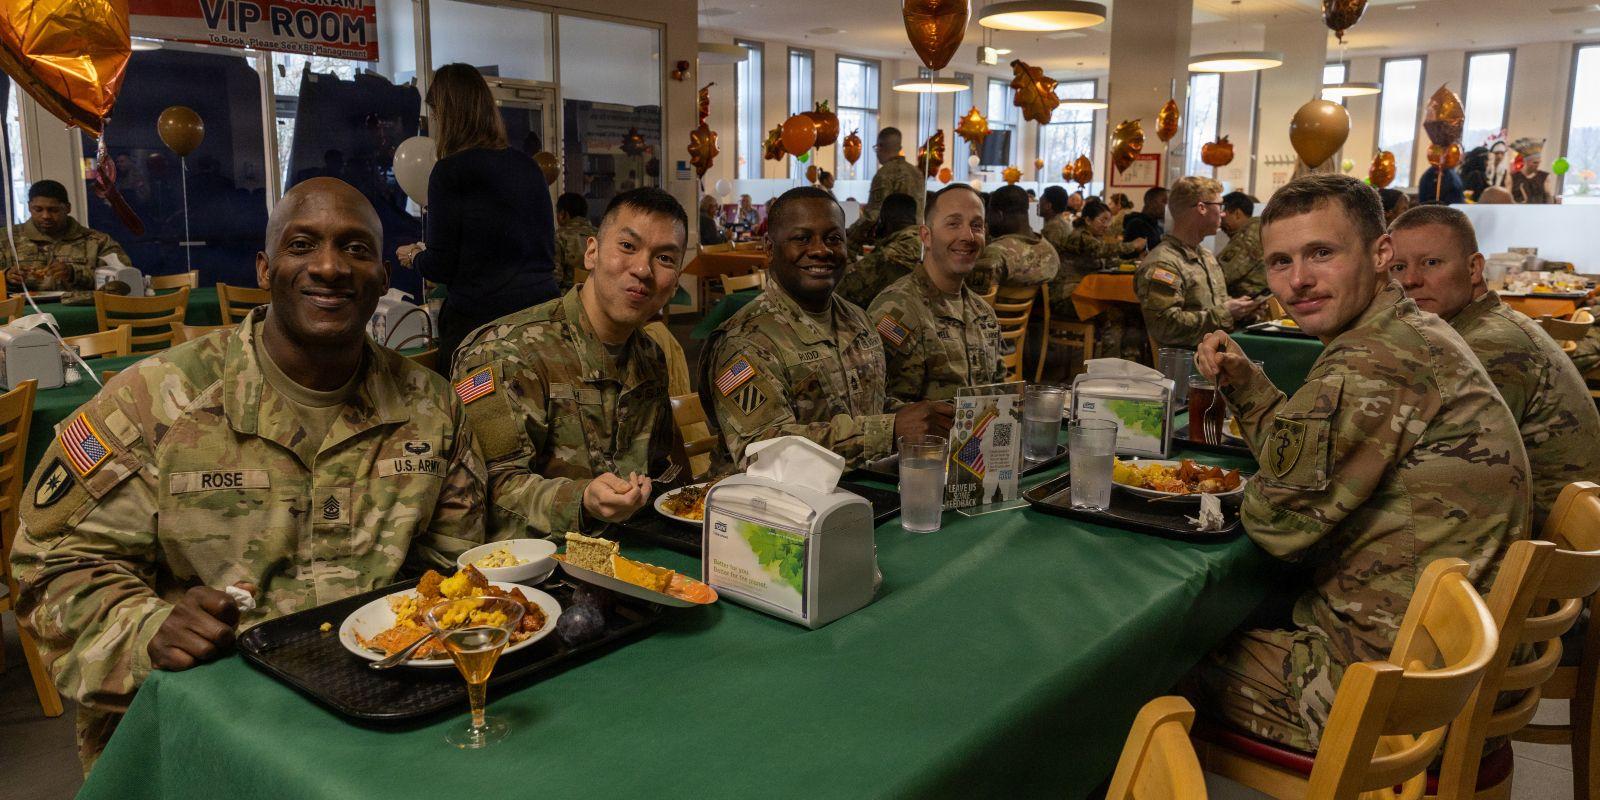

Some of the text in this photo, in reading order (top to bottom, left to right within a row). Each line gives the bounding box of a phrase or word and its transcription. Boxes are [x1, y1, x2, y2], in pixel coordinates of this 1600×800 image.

[201, 0, 367, 46] VIP ROOM
[209, 34, 220, 42] To
[249, 38, 279, 48] Please
[281, 41, 297, 50] See
[298, 43, 315, 52] KBR
[316, 45, 368, 58] Management
[798, 350, 819, 362] RUDD
[394, 459, 443, 473] U.S. ARMY
[201, 472, 243, 488] ROSE
[949, 483, 976, 493] LEAVE US
